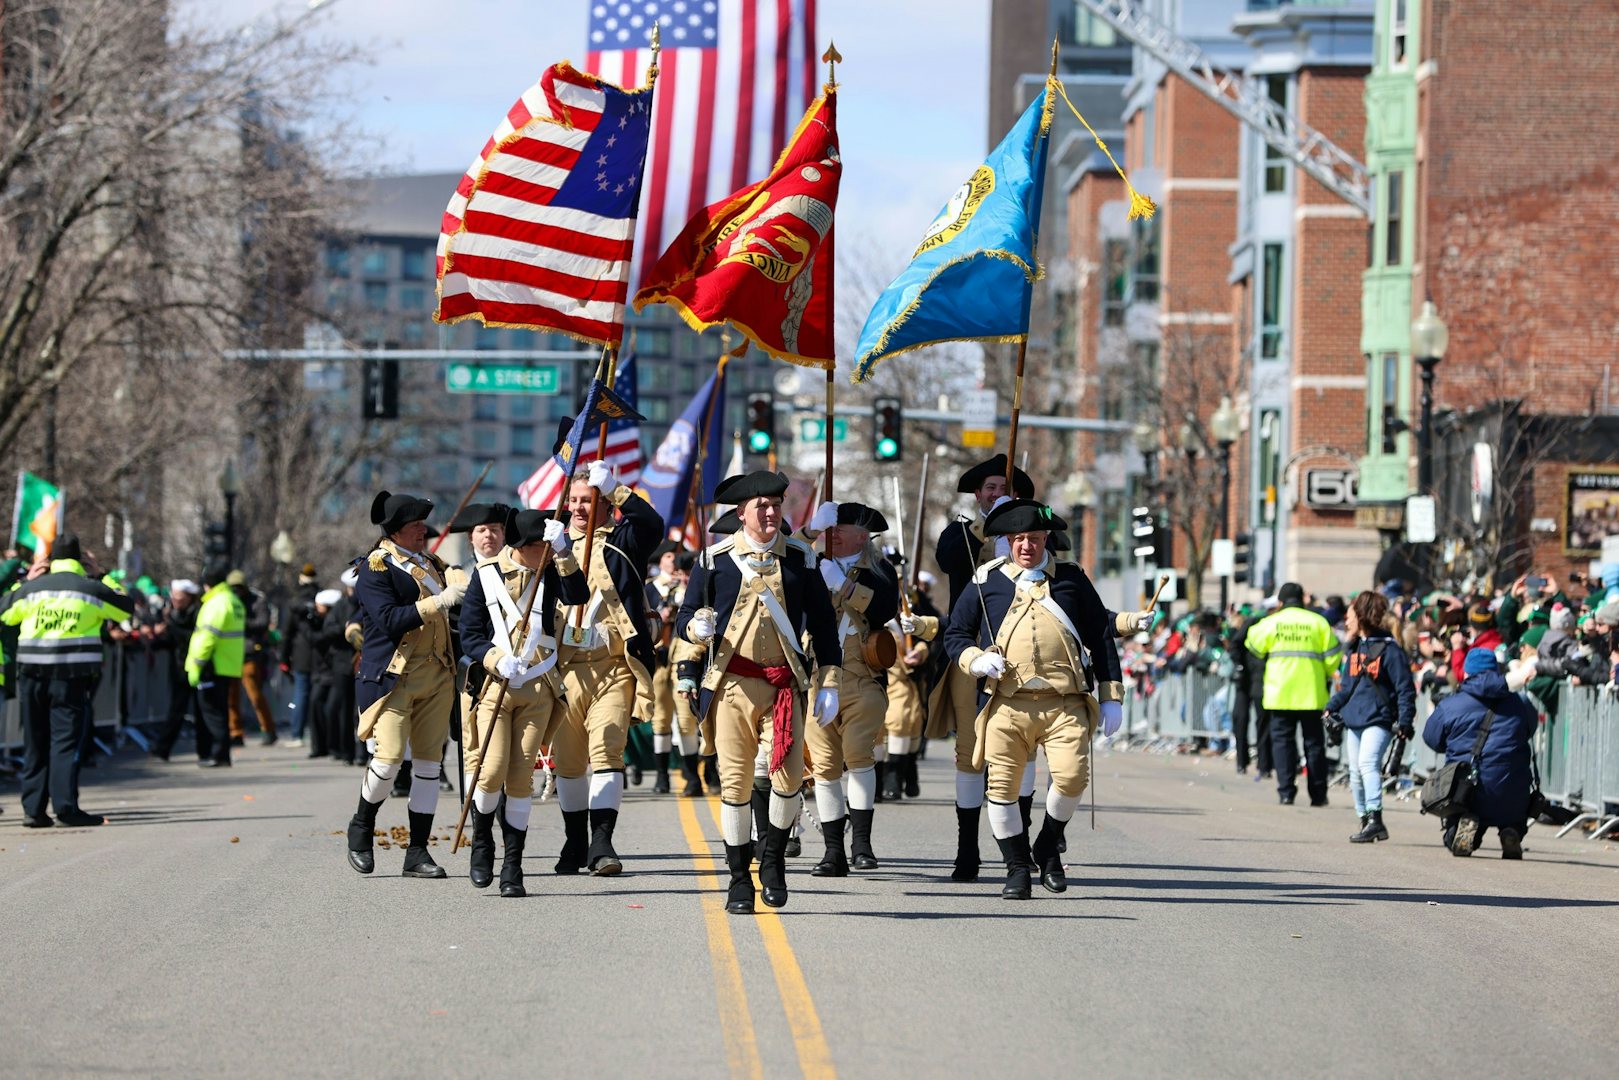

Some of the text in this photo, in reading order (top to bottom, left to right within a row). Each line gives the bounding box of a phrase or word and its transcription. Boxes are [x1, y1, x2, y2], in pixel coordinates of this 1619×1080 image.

[949, 212, 973, 231] FOR
[741, 253, 791, 282] VINCE
[475, 369, 550, 387] A STREET
[37, 605, 81, 620] Boston
[35, 618, 77, 633] Police
[1276, 622, 1311, 632] Boston
[1275, 632, 1311, 642] Police
